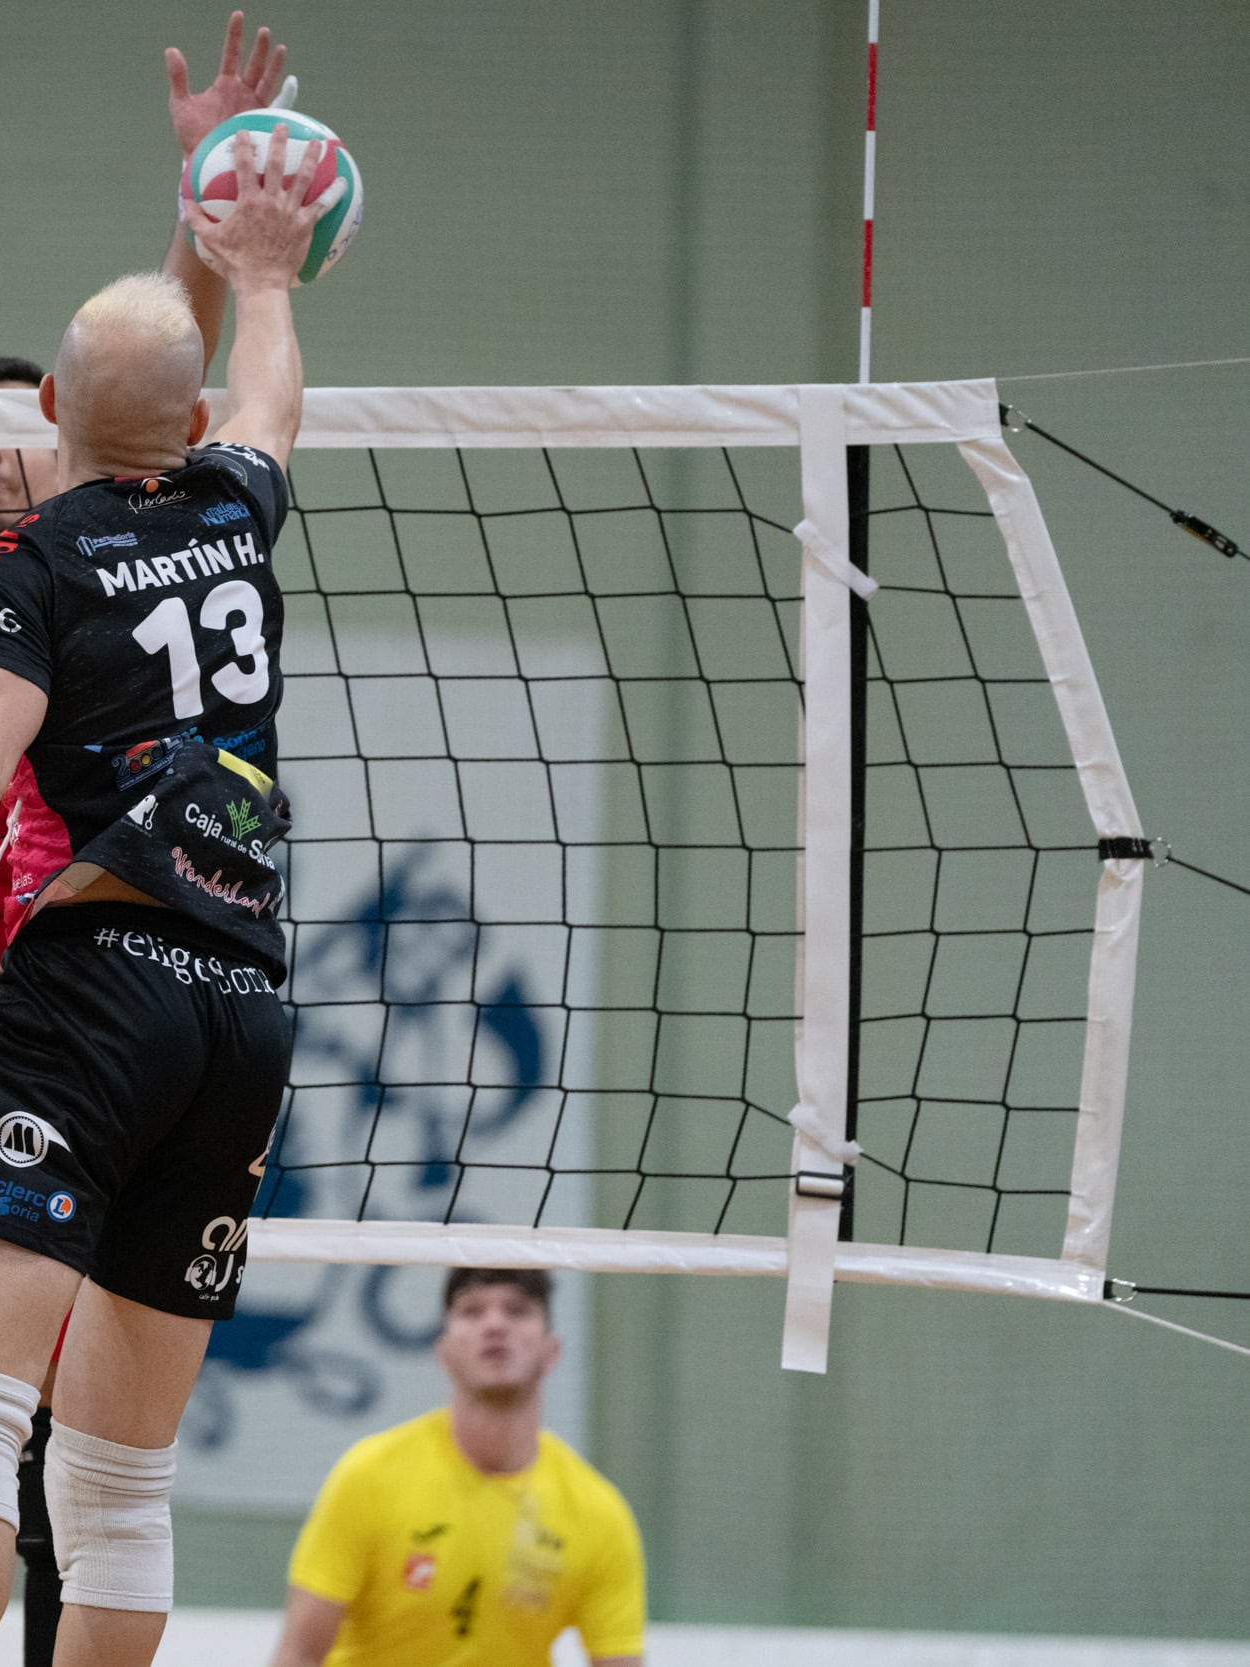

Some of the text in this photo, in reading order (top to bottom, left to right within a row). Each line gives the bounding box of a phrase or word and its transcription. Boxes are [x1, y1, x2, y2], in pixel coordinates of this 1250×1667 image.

[96, 532, 264, 598] MARTÍN H.
[131, 580, 270, 720] 13
[185, 803, 223, 838] Caja
[220, 835, 238, 849] rural
[237, 844, 247, 854] de
[171, 846, 271, 919] Wonderland
